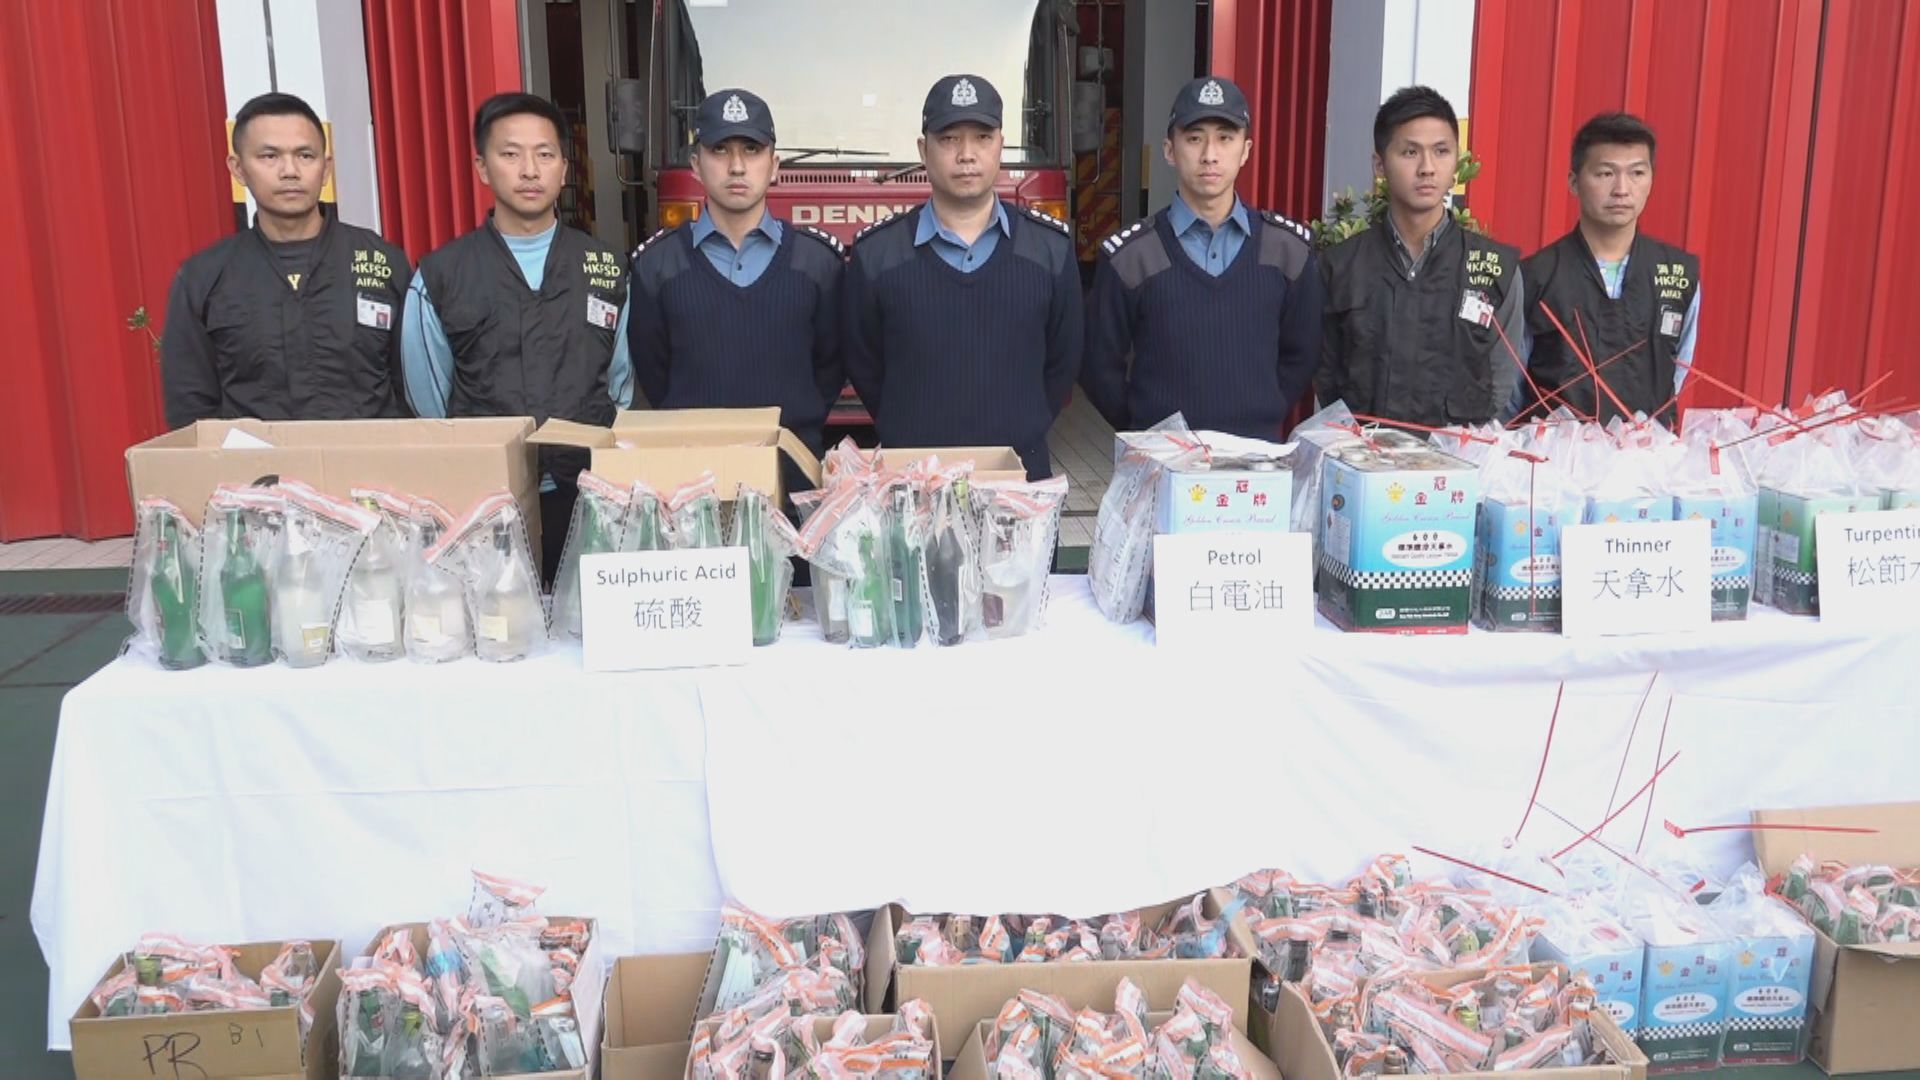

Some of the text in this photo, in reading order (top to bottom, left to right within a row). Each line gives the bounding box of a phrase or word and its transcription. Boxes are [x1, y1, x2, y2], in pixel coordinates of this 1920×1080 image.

[583, 262, 621, 277] HKFSD
[1604, 537, 1672, 554] Thinner
[1844, 524, 1920, 545] Turpenti
[1207, 548, 1262, 566] Petrol
[596, 562, 737, 588] Sulphuric Acid
[1592, 566, 1684, 600] 天拿水
[1189, 580, 1284, 612] 白電油
[634, 596, 703, 631] 硫酸
